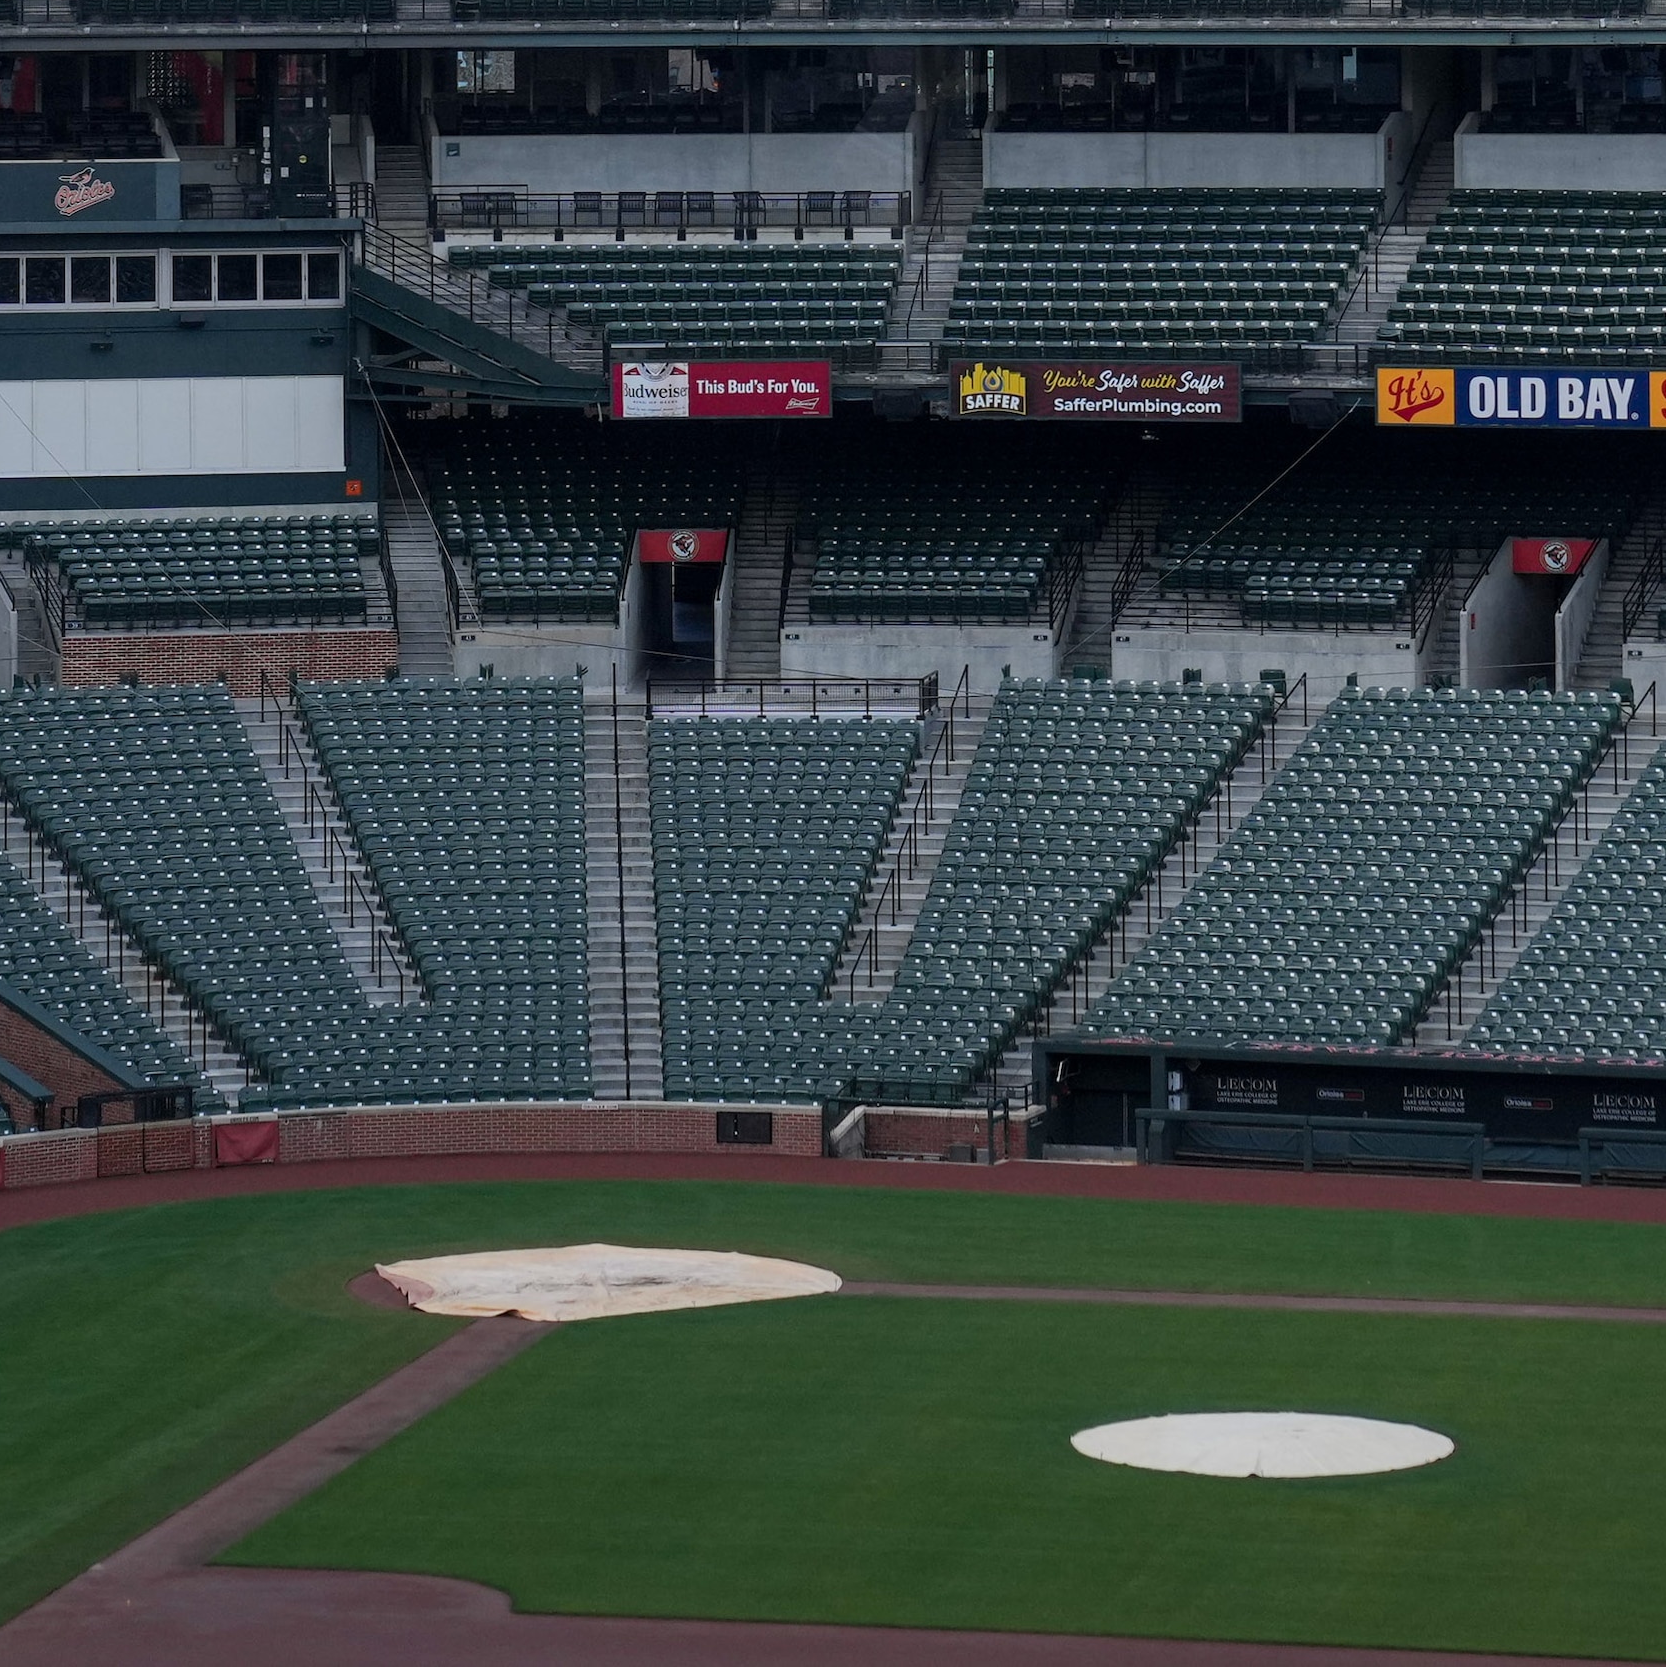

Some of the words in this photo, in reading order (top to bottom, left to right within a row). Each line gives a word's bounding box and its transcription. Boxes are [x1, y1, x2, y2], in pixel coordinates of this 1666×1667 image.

[55, 179, 115, 216] Orioles
[696, 379, 725, 394] This
[727, 379, 765, 394] Bud's
[767, 379, 789, 393] For
[790, 379, 820, 393] You.
[1043, 370, 1095, 393] You're
[1096, 370, 1139, 393] Safer
[1141, 373, 1176, 389] with
[1176, 371, 1225, 394] Saffer
[966, 393, 1020, 411] SAFFER
[1389, 370, 1444, 421] It's
[1469, 376, 1546, 419] OLD
[1558, 377, 1635, 420] BAY
[1054, 397, 1221, 416] SafferPlumbing.com
